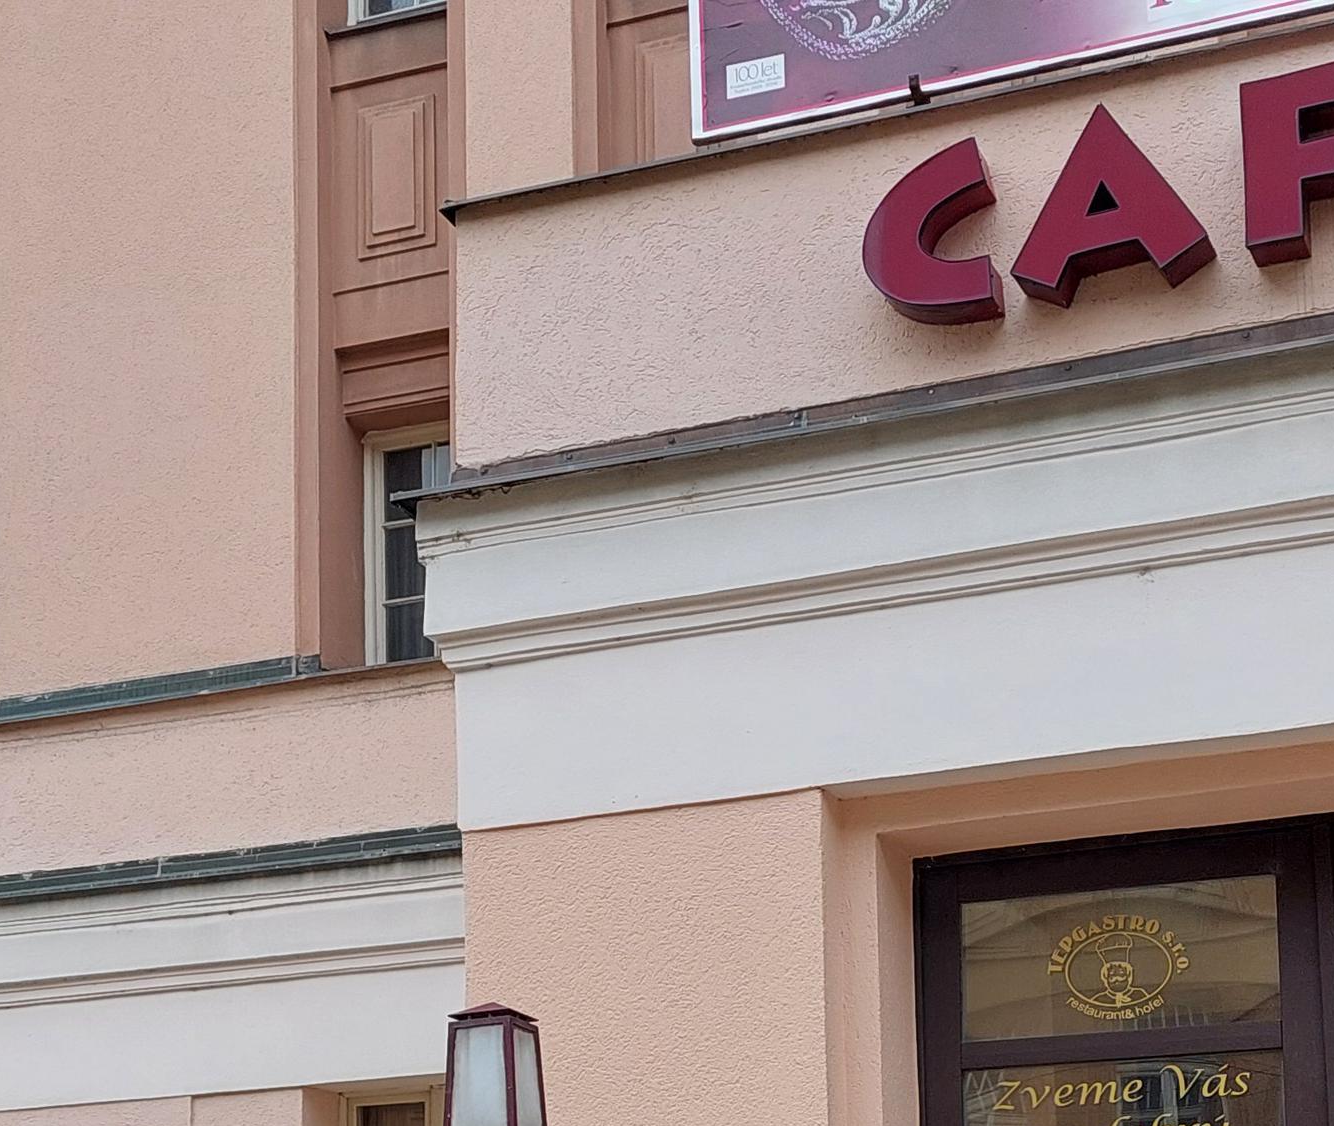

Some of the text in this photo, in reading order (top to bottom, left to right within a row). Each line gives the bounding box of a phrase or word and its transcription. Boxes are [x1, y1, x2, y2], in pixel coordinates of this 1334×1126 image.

[735, 63, 759, 83] 100
[761, 61, 779, 78] let
[1047, 914, 1161, 976] TEPGASTRO
[993, 1063, 1252, 1111] Zveme Vás
